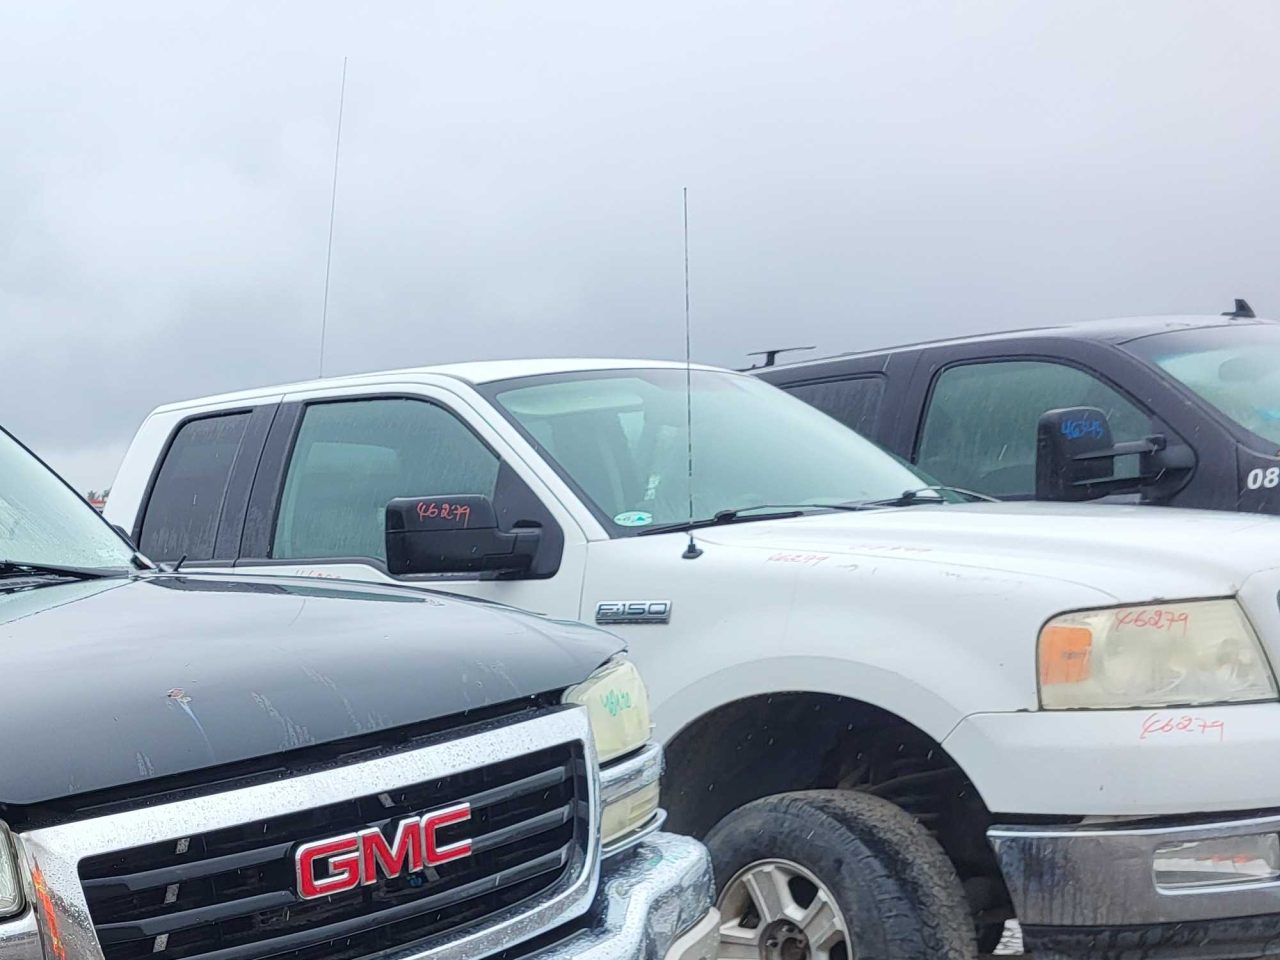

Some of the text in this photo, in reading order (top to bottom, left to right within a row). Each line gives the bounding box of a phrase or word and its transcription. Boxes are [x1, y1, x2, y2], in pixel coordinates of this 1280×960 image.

[1247, 466, 1280, 490] 08
[416, 501, 471, 528] 46279
[597, 601, 671, 619] F-150
[295, 802, 472, 900] GMC
